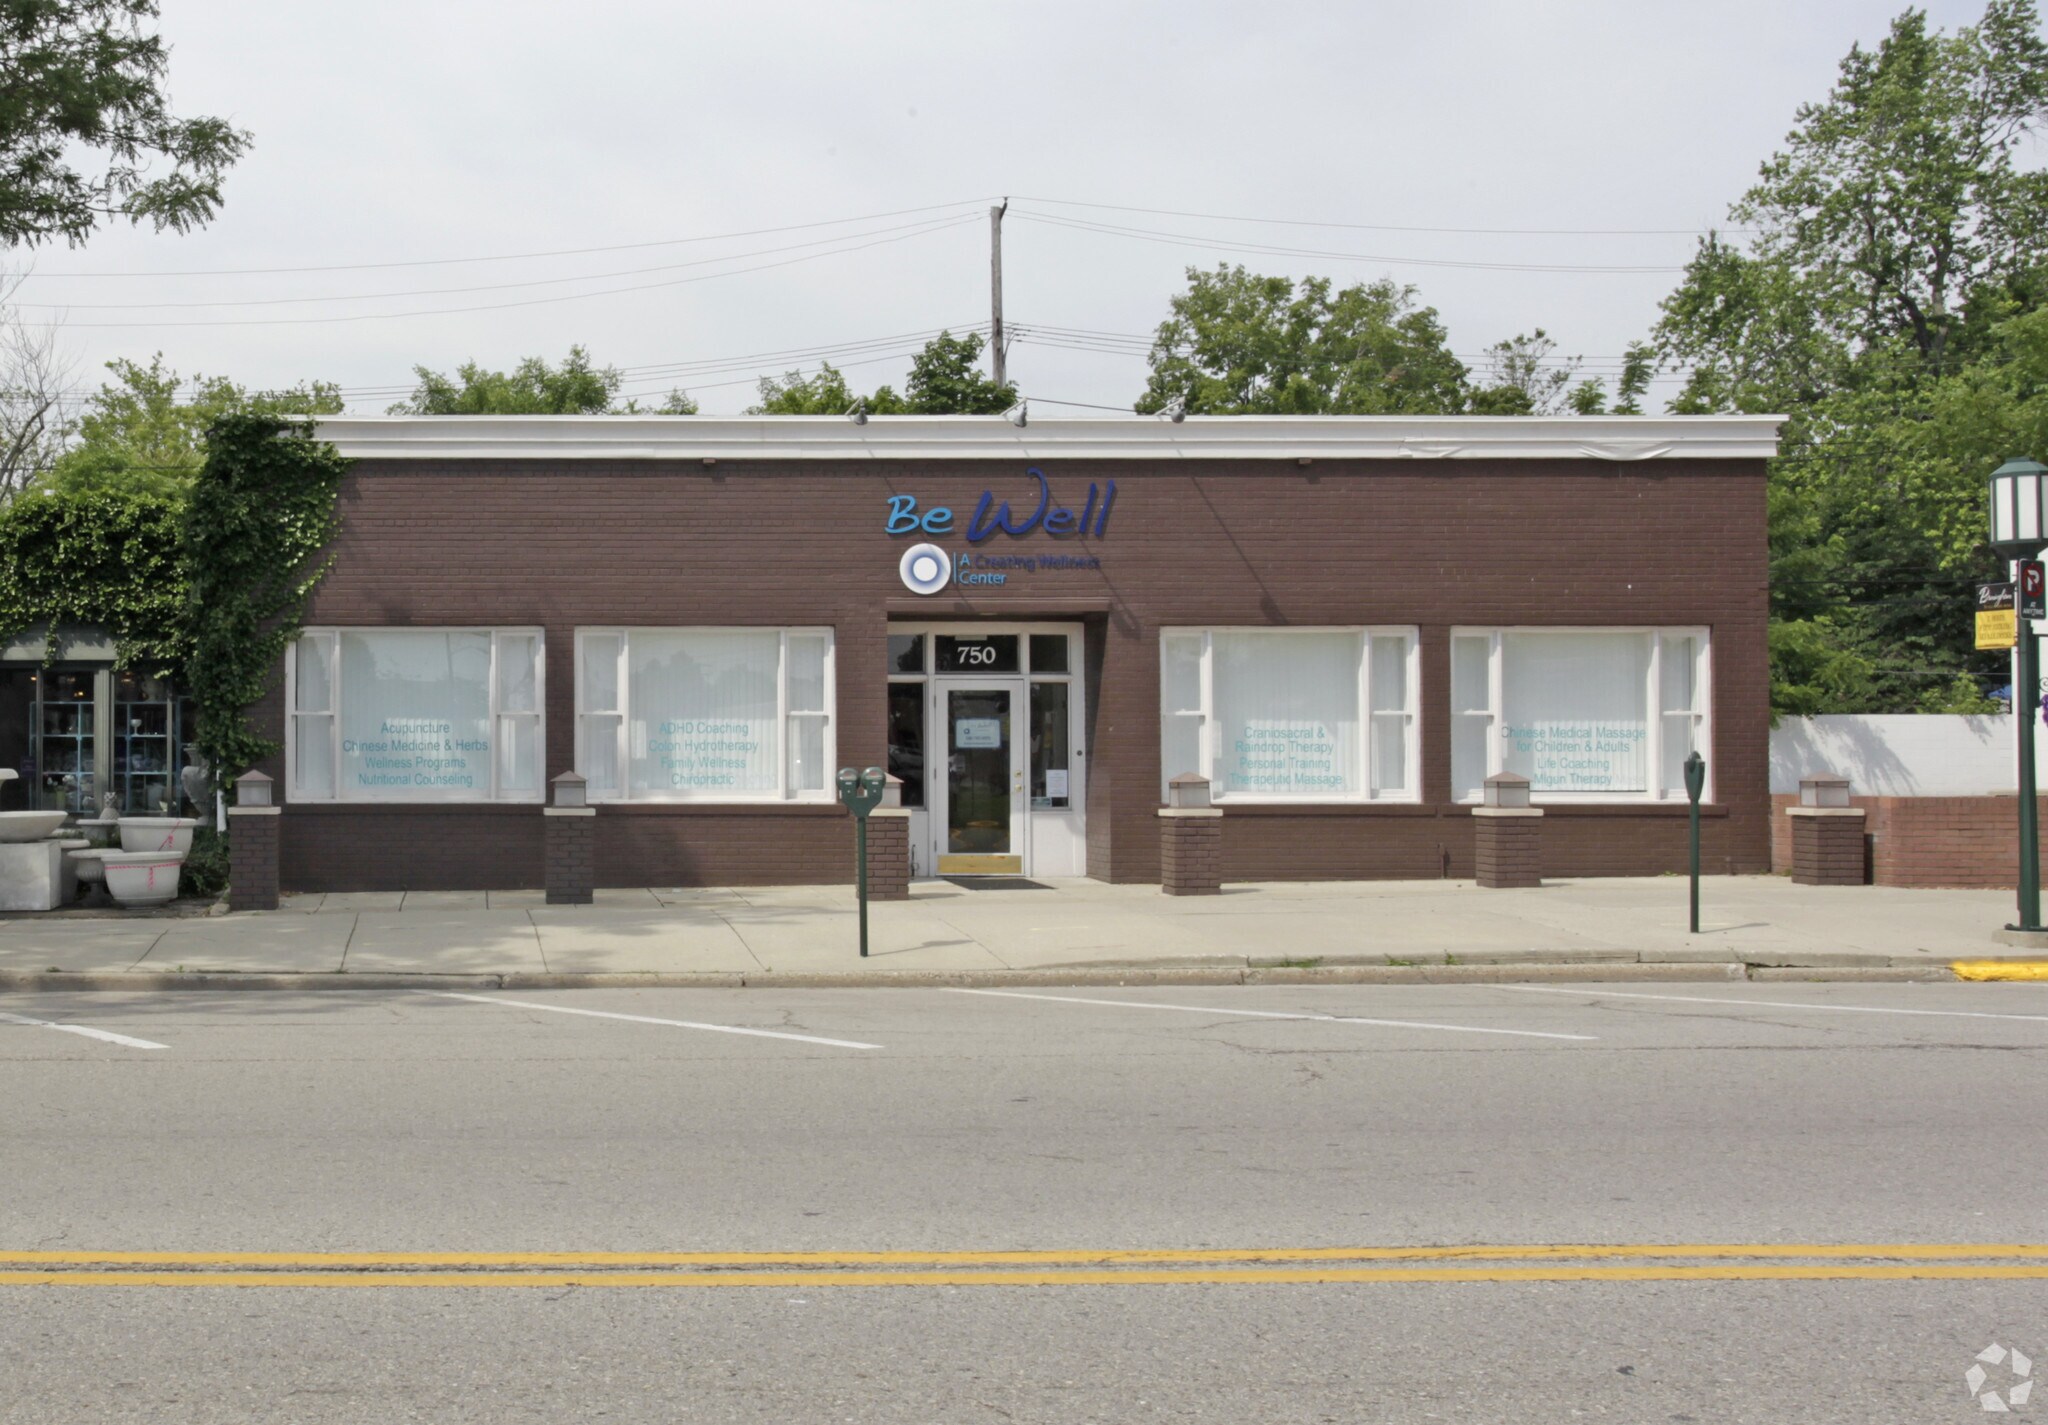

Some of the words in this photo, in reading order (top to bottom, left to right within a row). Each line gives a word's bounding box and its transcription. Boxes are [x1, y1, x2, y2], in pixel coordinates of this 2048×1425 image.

[884, 494, 954, 534] Be
[966, 466, 1116, 542] Well
[959, 553, 970, 566] A
[974, 555, 1036, 571] Creating
[1039, 555, 1100, 570] Wellness
[959, 571, 1007, 585] Center
[957, 646, 996, 665] 750
[381, 722, 450, 735] Acupuncture
[659, 722, 694, 734] ADHD
[696, 722, 749, 736] Coaching
[1244, 726, 1314, 739] Craniosacral
[1317, 726, 1325, 738] &
[1501, 726, 1546, 739] Chinese
[1549, 726, 1592, 739] Medical
[1595, 726, 1646, 741] Massage
[343, 739, 387, 752] Chinese
[391, 739, 440, 751] Medicine
[443, 739, 451, 751] &
[455, 739, 488, 751] Herbs
[649, 739, 681, 752] Colon
[684, 739, 759, 753] Hydrotherapy
[1235, 740, 1285, 755] Raindrop
[1288, 741, 1334, 755] Therapy
[1517, 741, 1532, 752] for
[1534, 741, 1580, 753] Children
[1584, 741, 1592, 753] &
[1595, 741, 1630, 753] Adults
[365, 756, 412, 769] Wellness
[415, 756, 466, 771] Programs
[660, 756, 695, 770] Family
[698, 756, 746, 769] Wellness
[1239, 757, 1286, 769] Personal
[1289, 757, 1331, 771] Training
[1537, 757, 1556, 769] Life
[1559, 757, 1610, 771] Coaching
[358, 773, 411, 786] Nutritional
[414, 773, 473, 787] Counseling
[671, 773, 735, 787] Chiropractic
[1229, 773, 1291, 786] Therapeutic
[1294, 773, 1342, 787] Massage
[1569, 773, 1613, 787] Therapy
